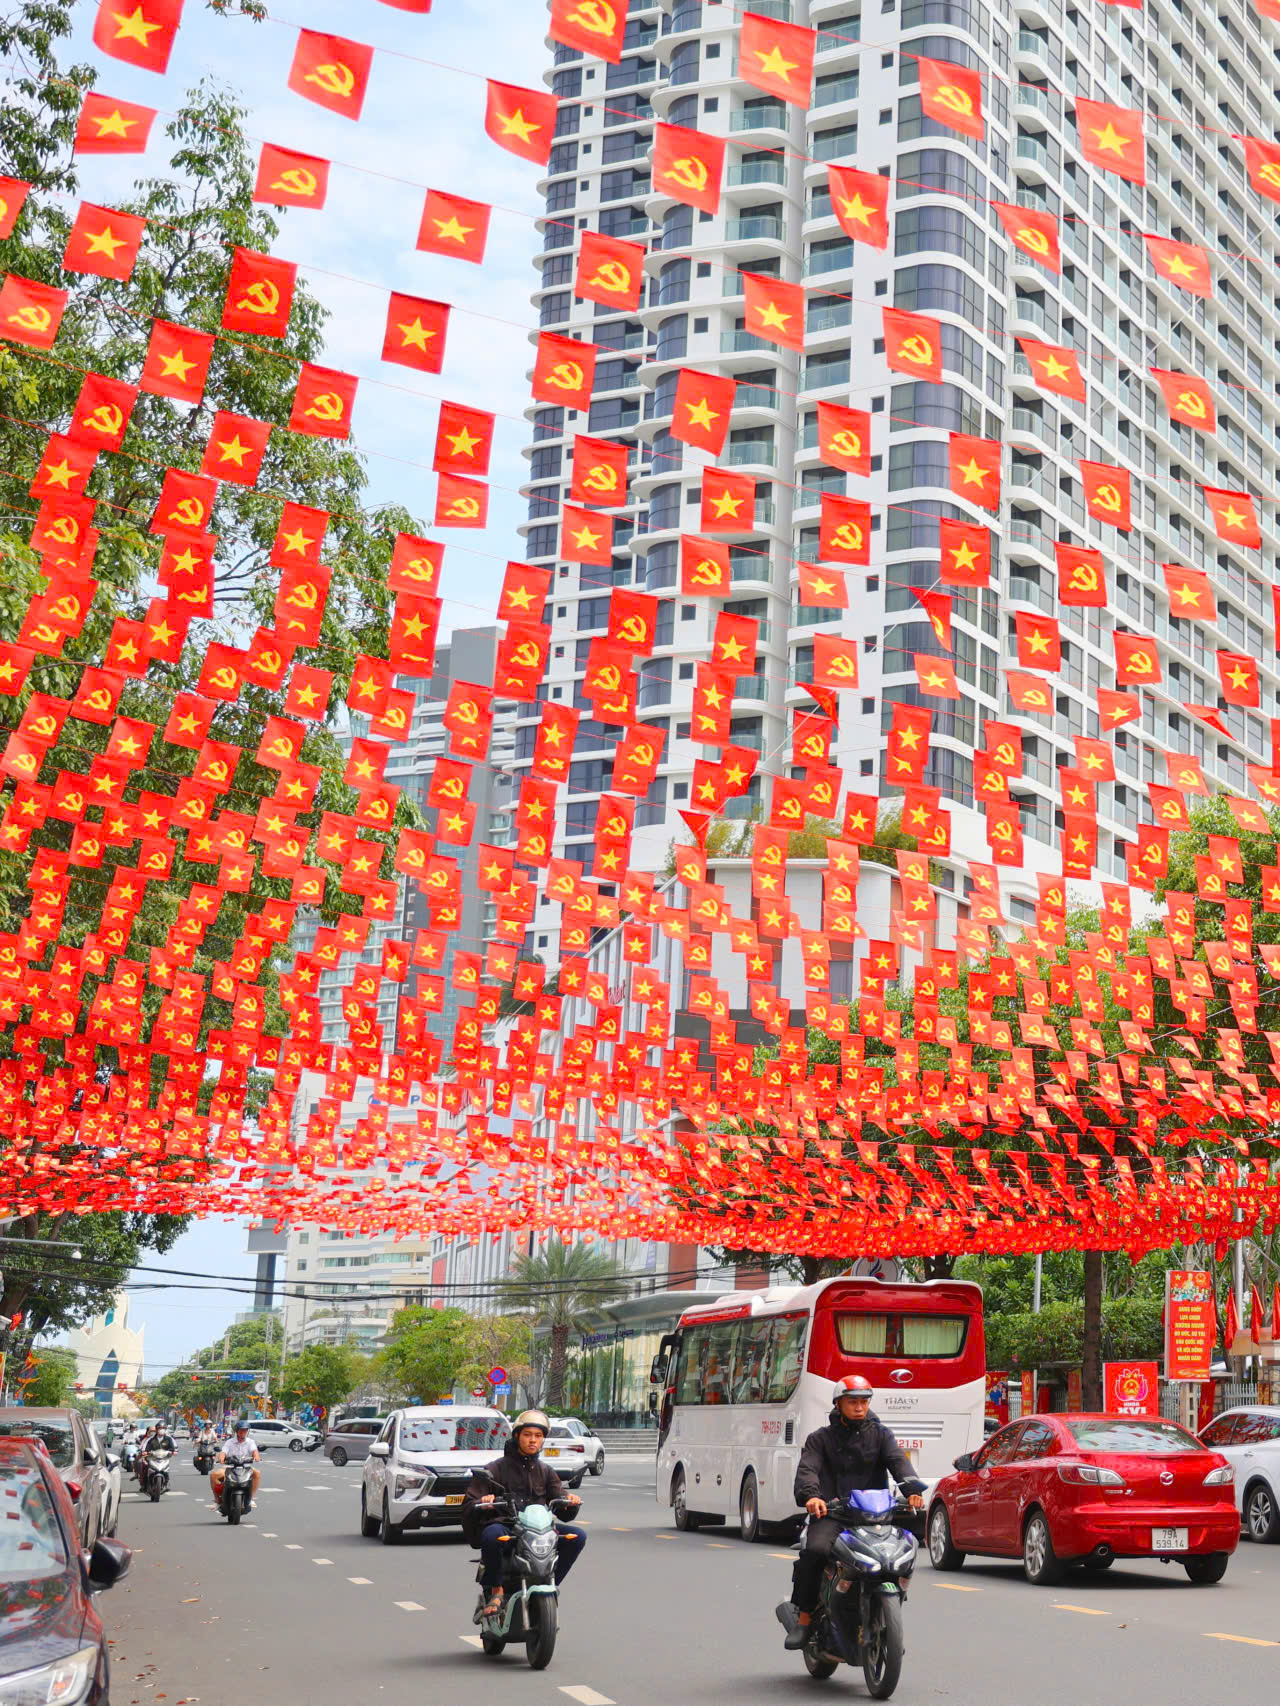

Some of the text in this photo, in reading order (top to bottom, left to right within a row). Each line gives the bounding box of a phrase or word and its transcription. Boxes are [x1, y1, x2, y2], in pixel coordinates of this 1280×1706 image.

[1118, 1406, 1147, 1414] XVI
[1162, 1530, 1178, 1539] 79A
[1156, 1540, 1184, 1548] 539.14
